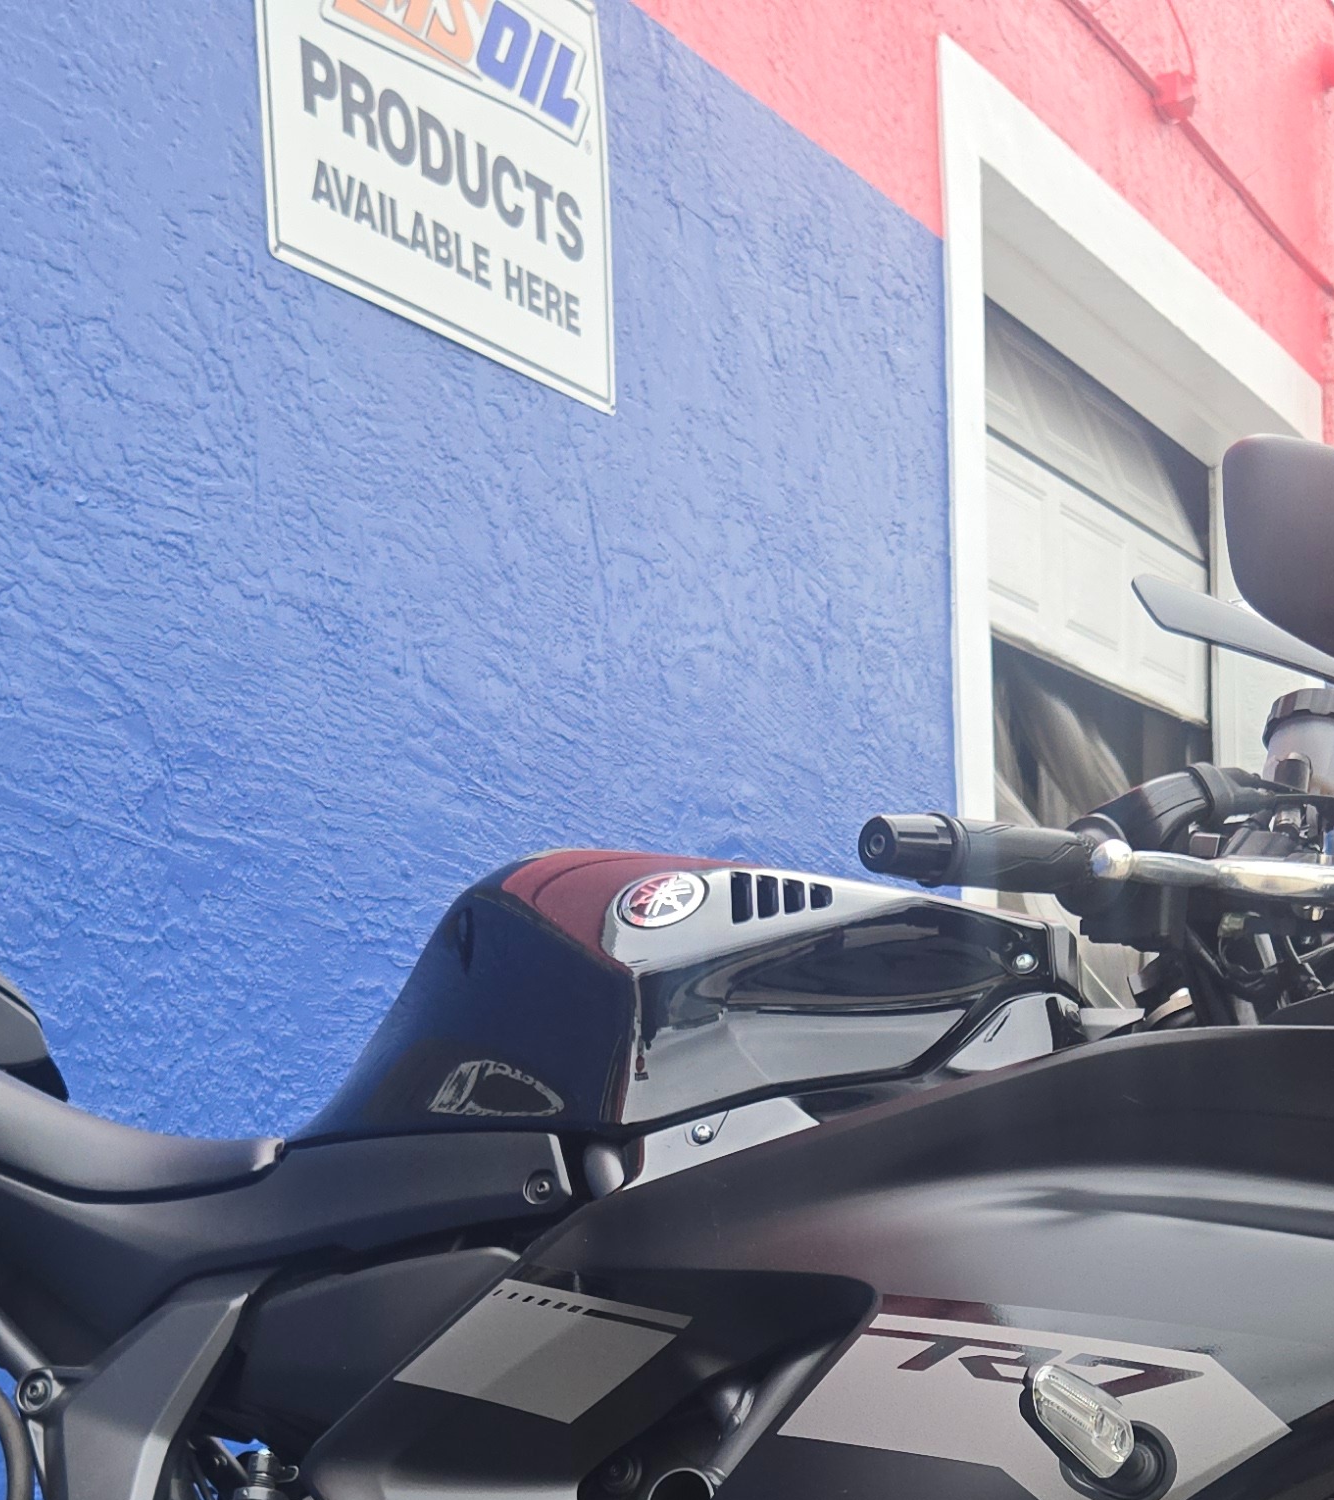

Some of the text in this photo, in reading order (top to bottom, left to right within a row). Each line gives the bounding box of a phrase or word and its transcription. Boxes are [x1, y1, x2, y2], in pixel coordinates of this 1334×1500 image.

[299, 35, 584, 262] PRODUCTS
[311, 159, 581, 337] AVAILABLE HERE
